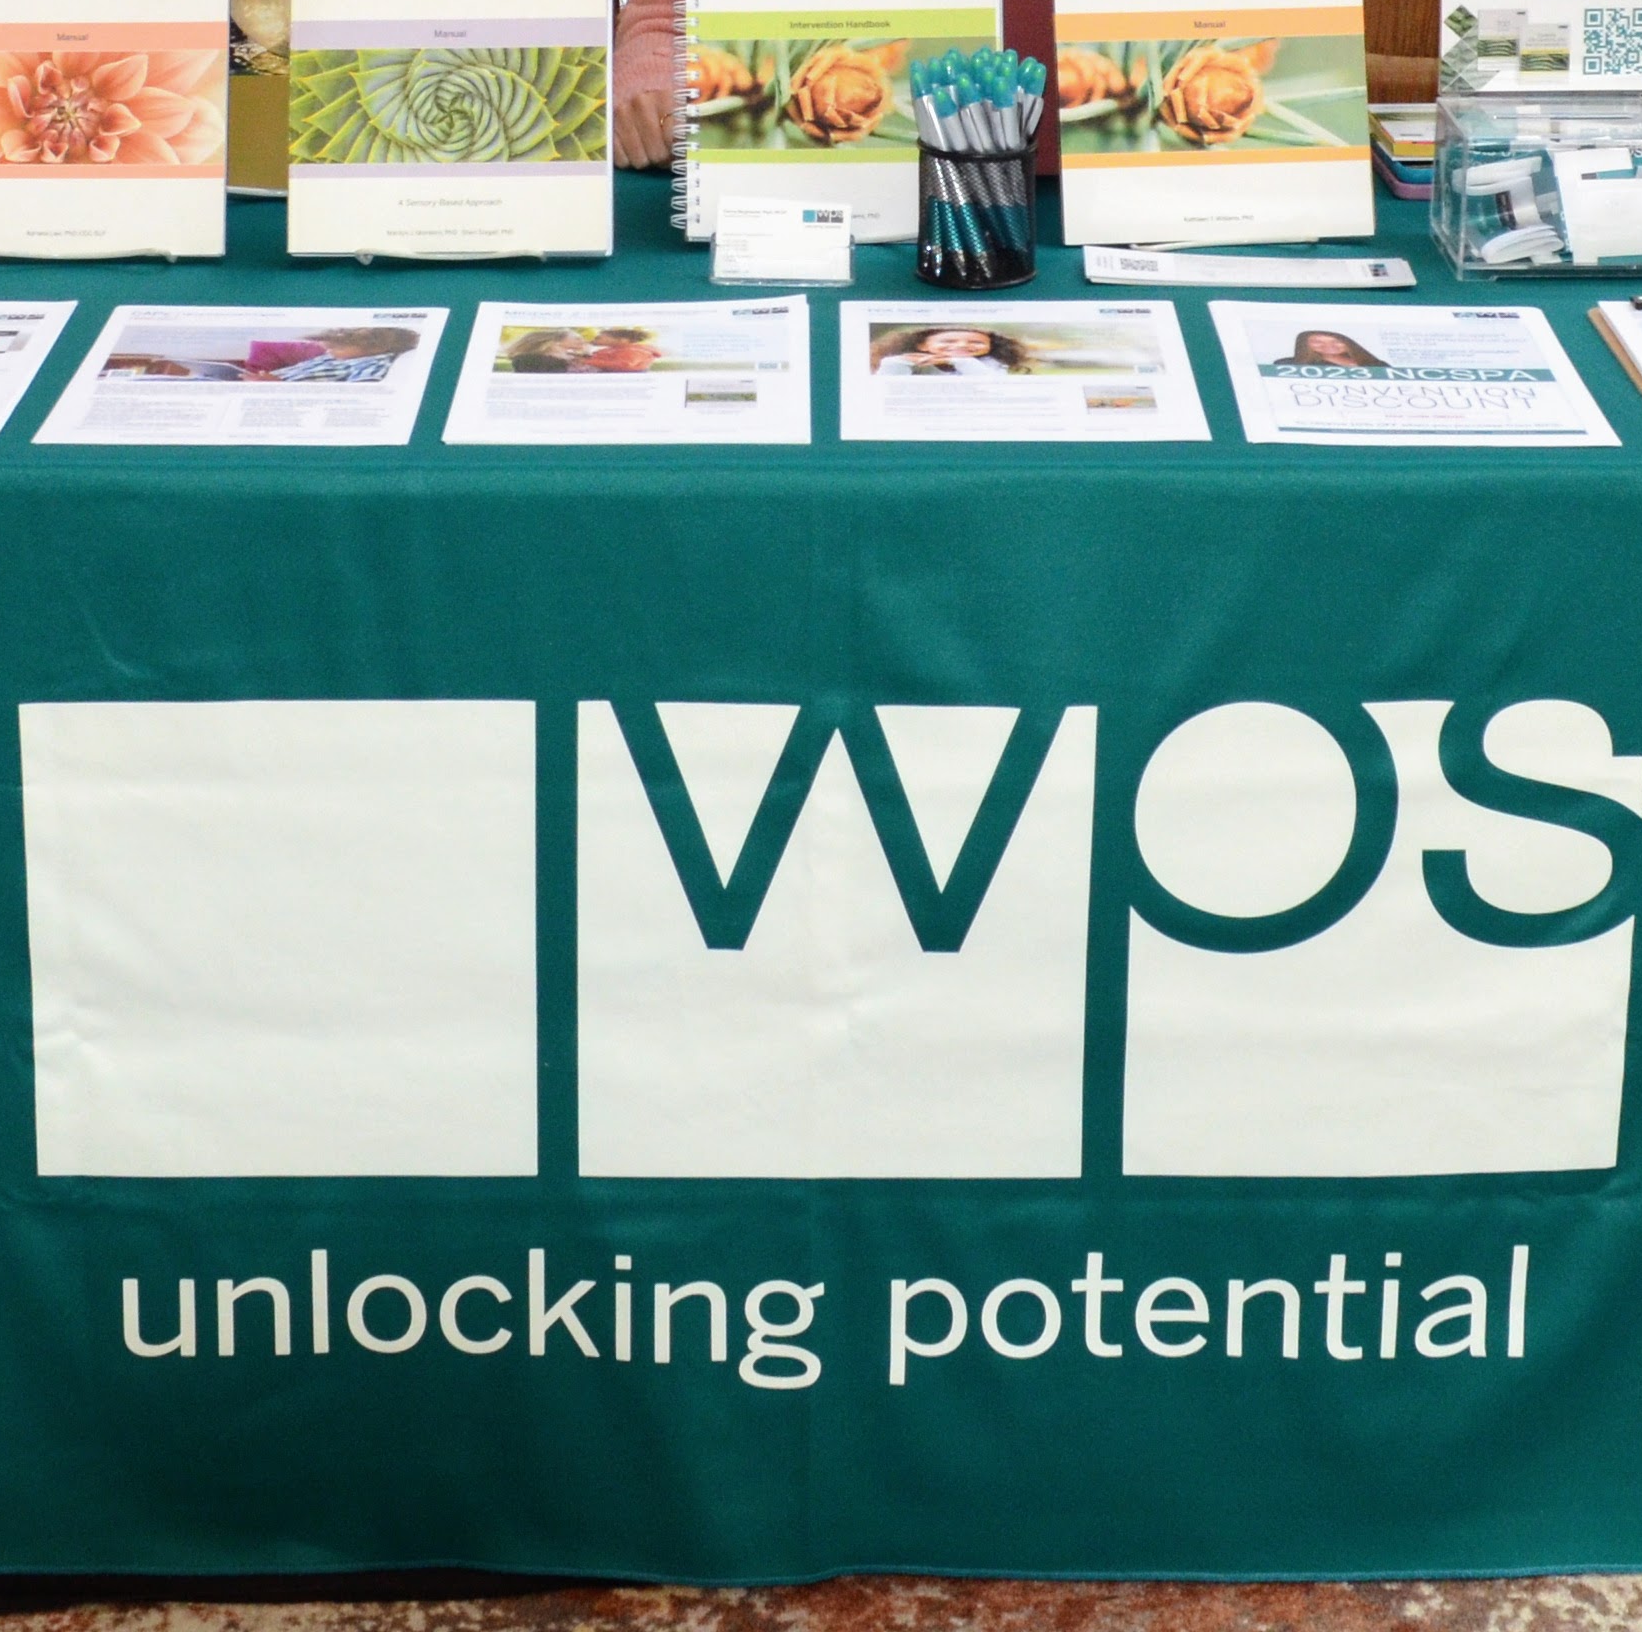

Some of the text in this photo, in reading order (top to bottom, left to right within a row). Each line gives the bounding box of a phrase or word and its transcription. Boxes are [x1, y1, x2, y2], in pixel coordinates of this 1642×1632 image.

[789, 19, 891, 30] Intervention Handbook
[1193, 20, 1226, 30] Manual
[56, 32, 90, 42] Manual
[433, 29, 467, 39] Manual
[1274, 365, 1539, 382] 2023 NCSPA
[1289, 383, 1537, 399] CONVENTION
[1294, 393, 1539, 410] DISCOUNT
[121, 1244, 1530, 1391] unlocking potential
